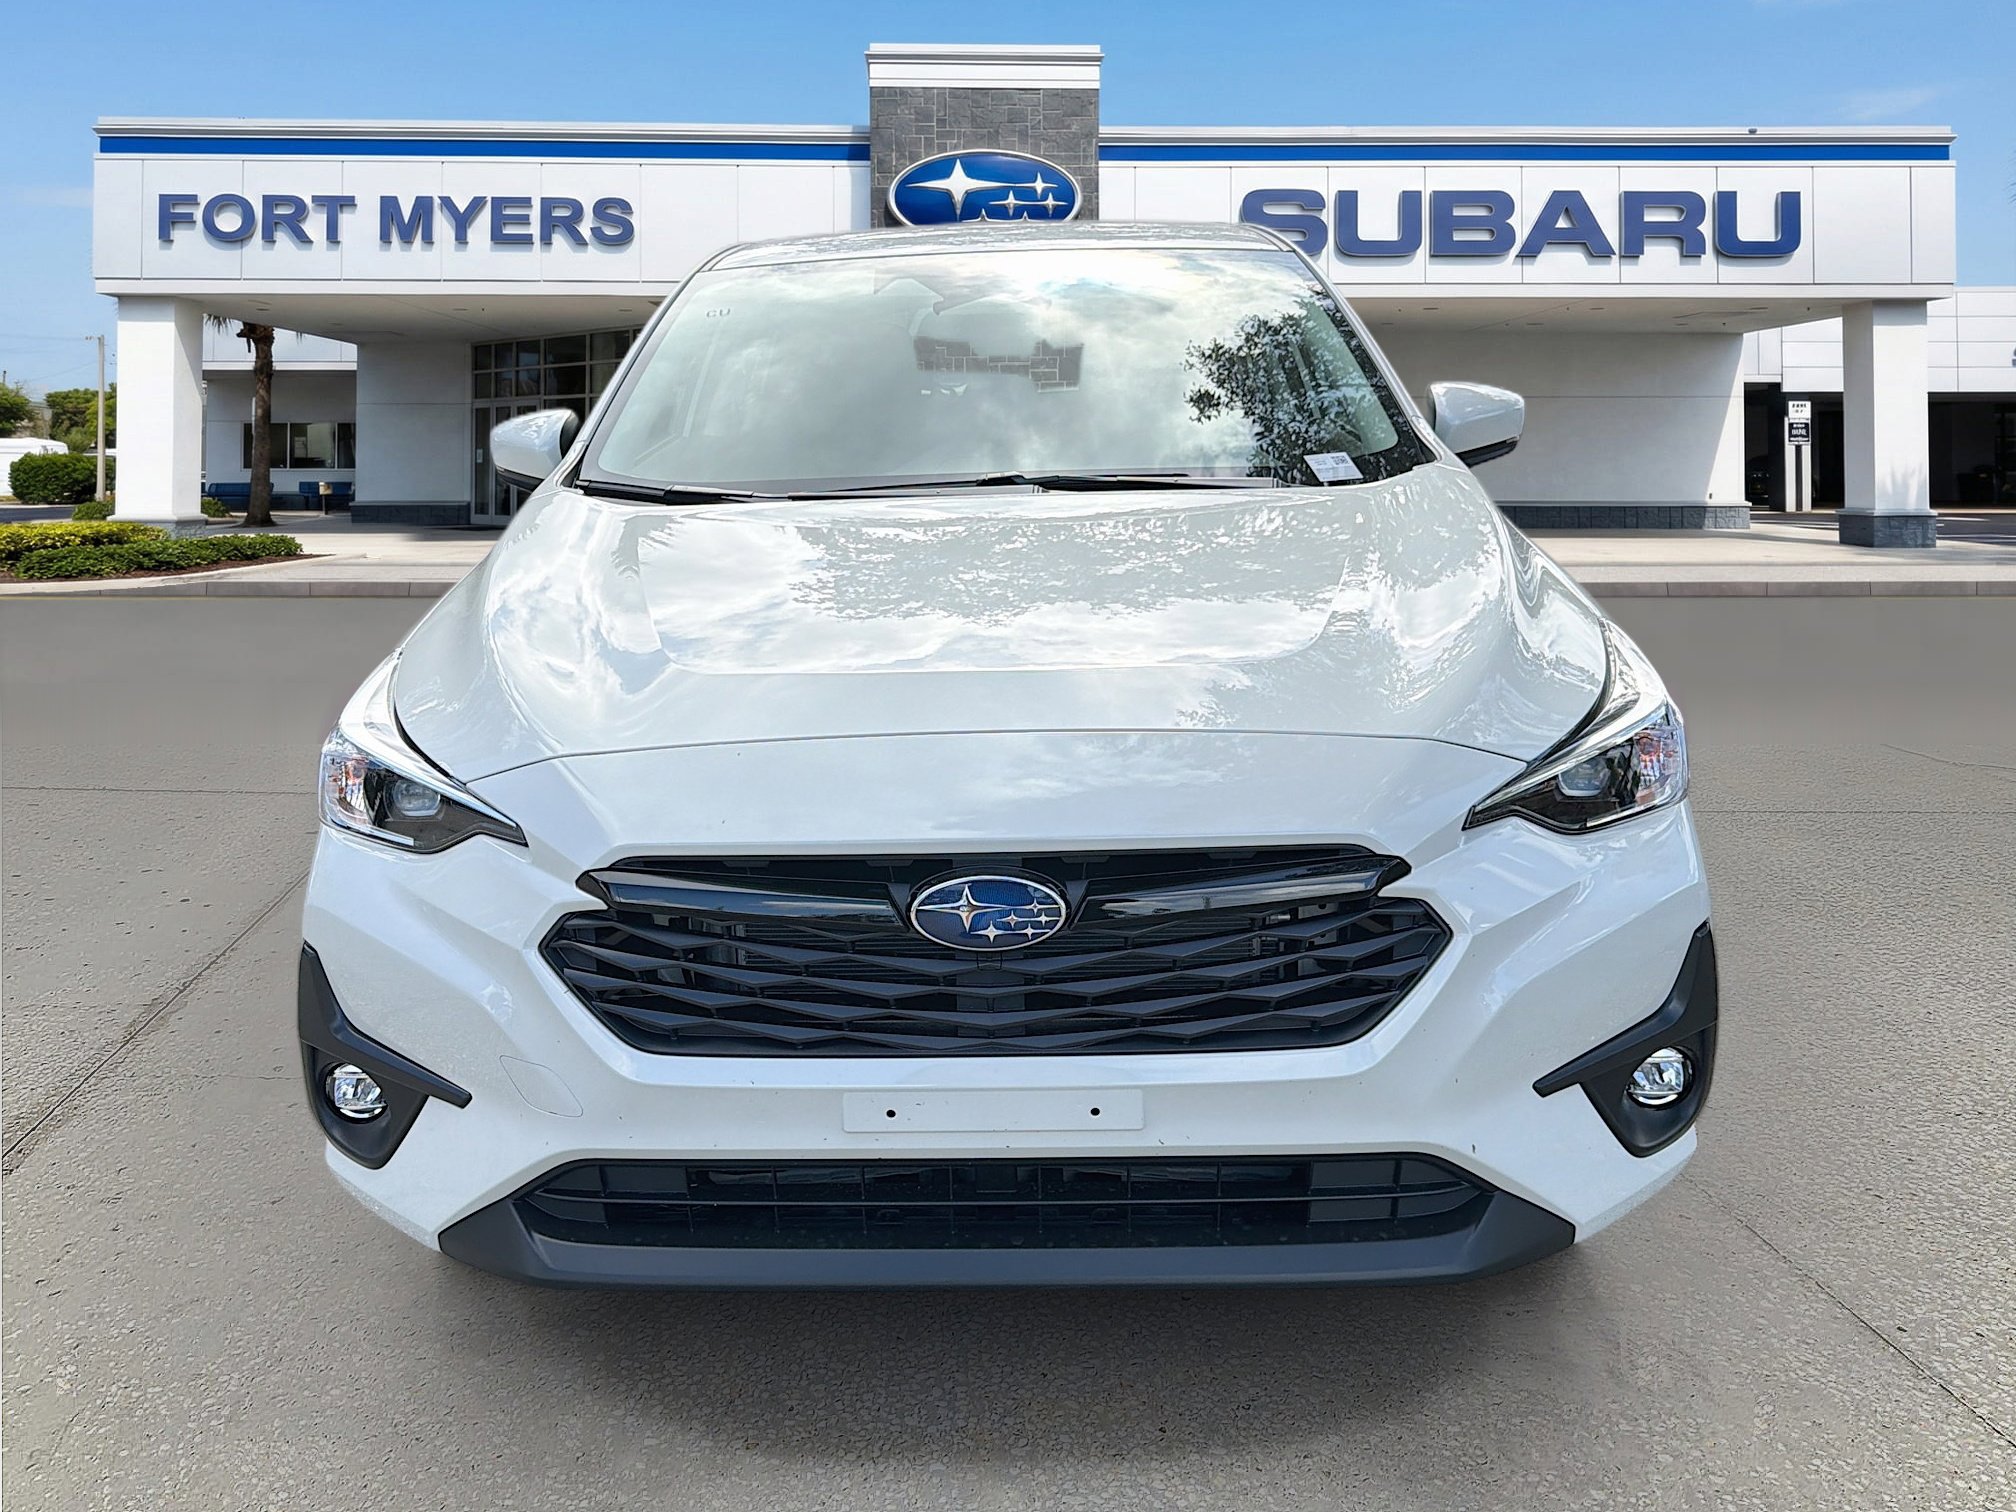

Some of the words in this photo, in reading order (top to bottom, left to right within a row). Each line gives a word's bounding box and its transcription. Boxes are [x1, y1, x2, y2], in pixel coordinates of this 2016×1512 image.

[158, 193, 357, 243] FORT
[379, 195, 635, 246] MYERS
[1239, 188, 1801, 258] SUBARU
